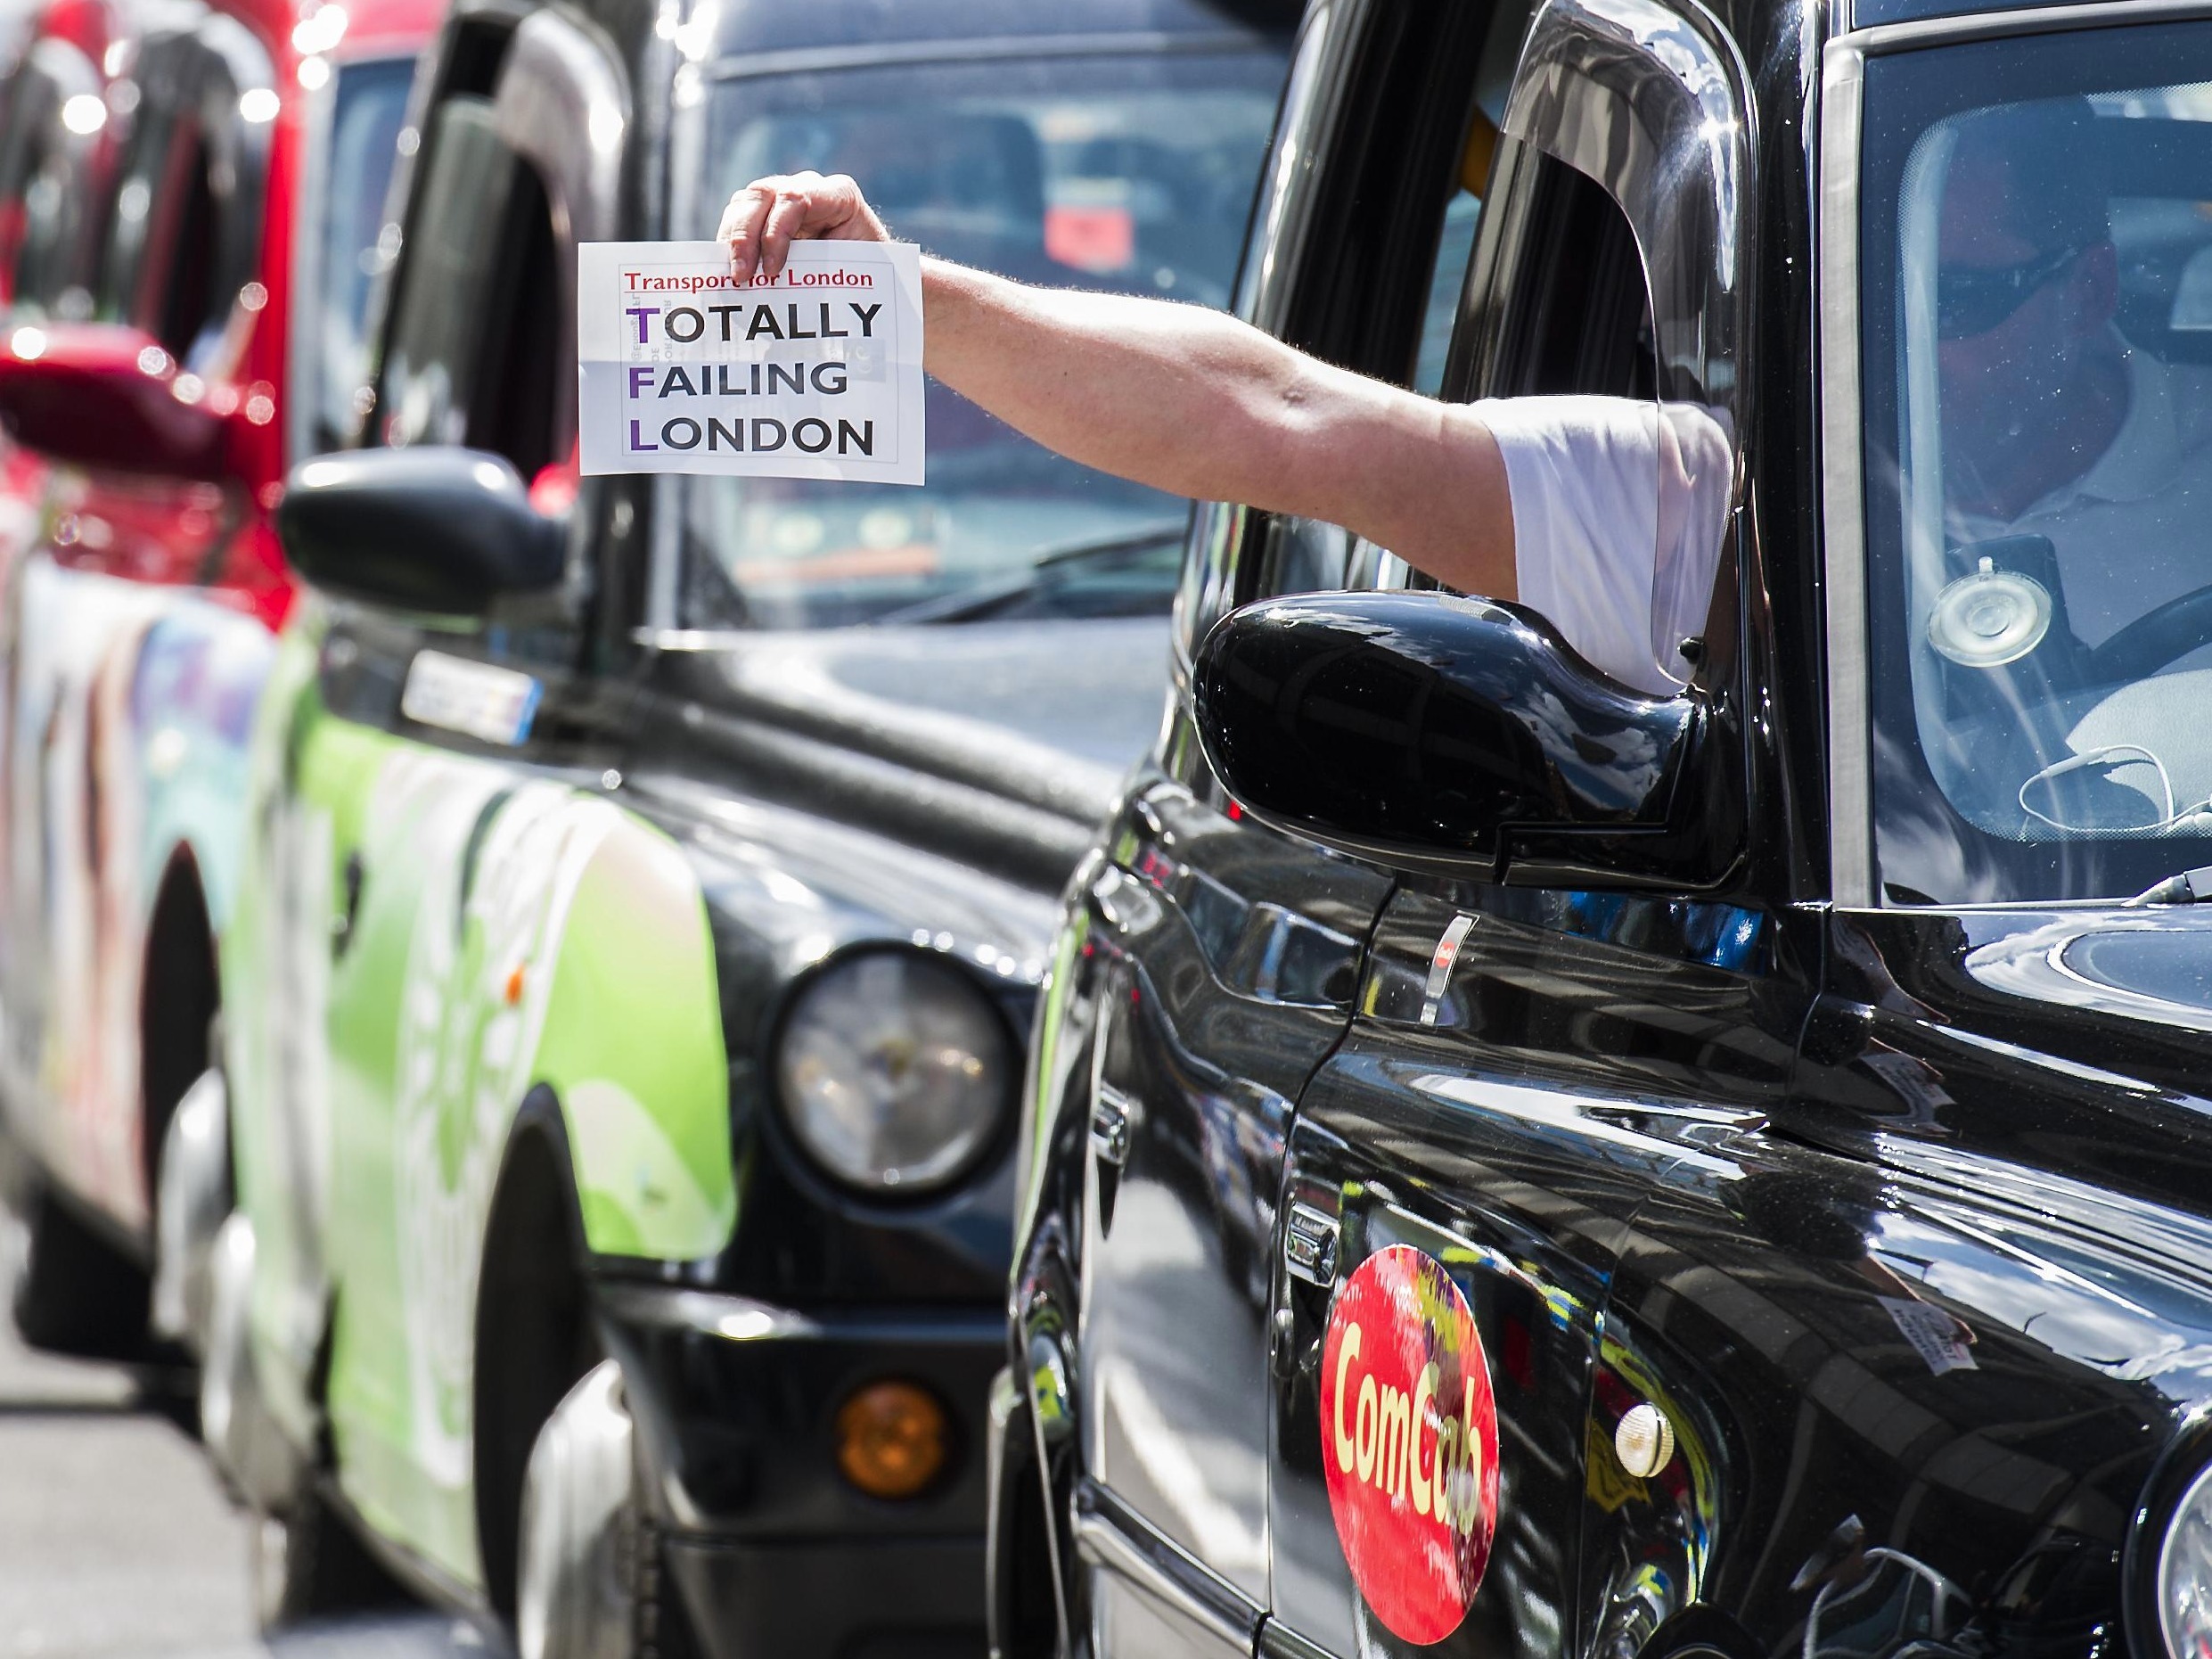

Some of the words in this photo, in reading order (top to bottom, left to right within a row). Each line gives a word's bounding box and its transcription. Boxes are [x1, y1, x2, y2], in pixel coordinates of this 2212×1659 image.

[788, 268, 873, 286] London
[626, 303, 882, 343] TOTALLY
[629, 362, 848, 398] FAILING
[630, 417, 873, 456] LONDON
[1334, 1322, 1481, 1536] ComCab
